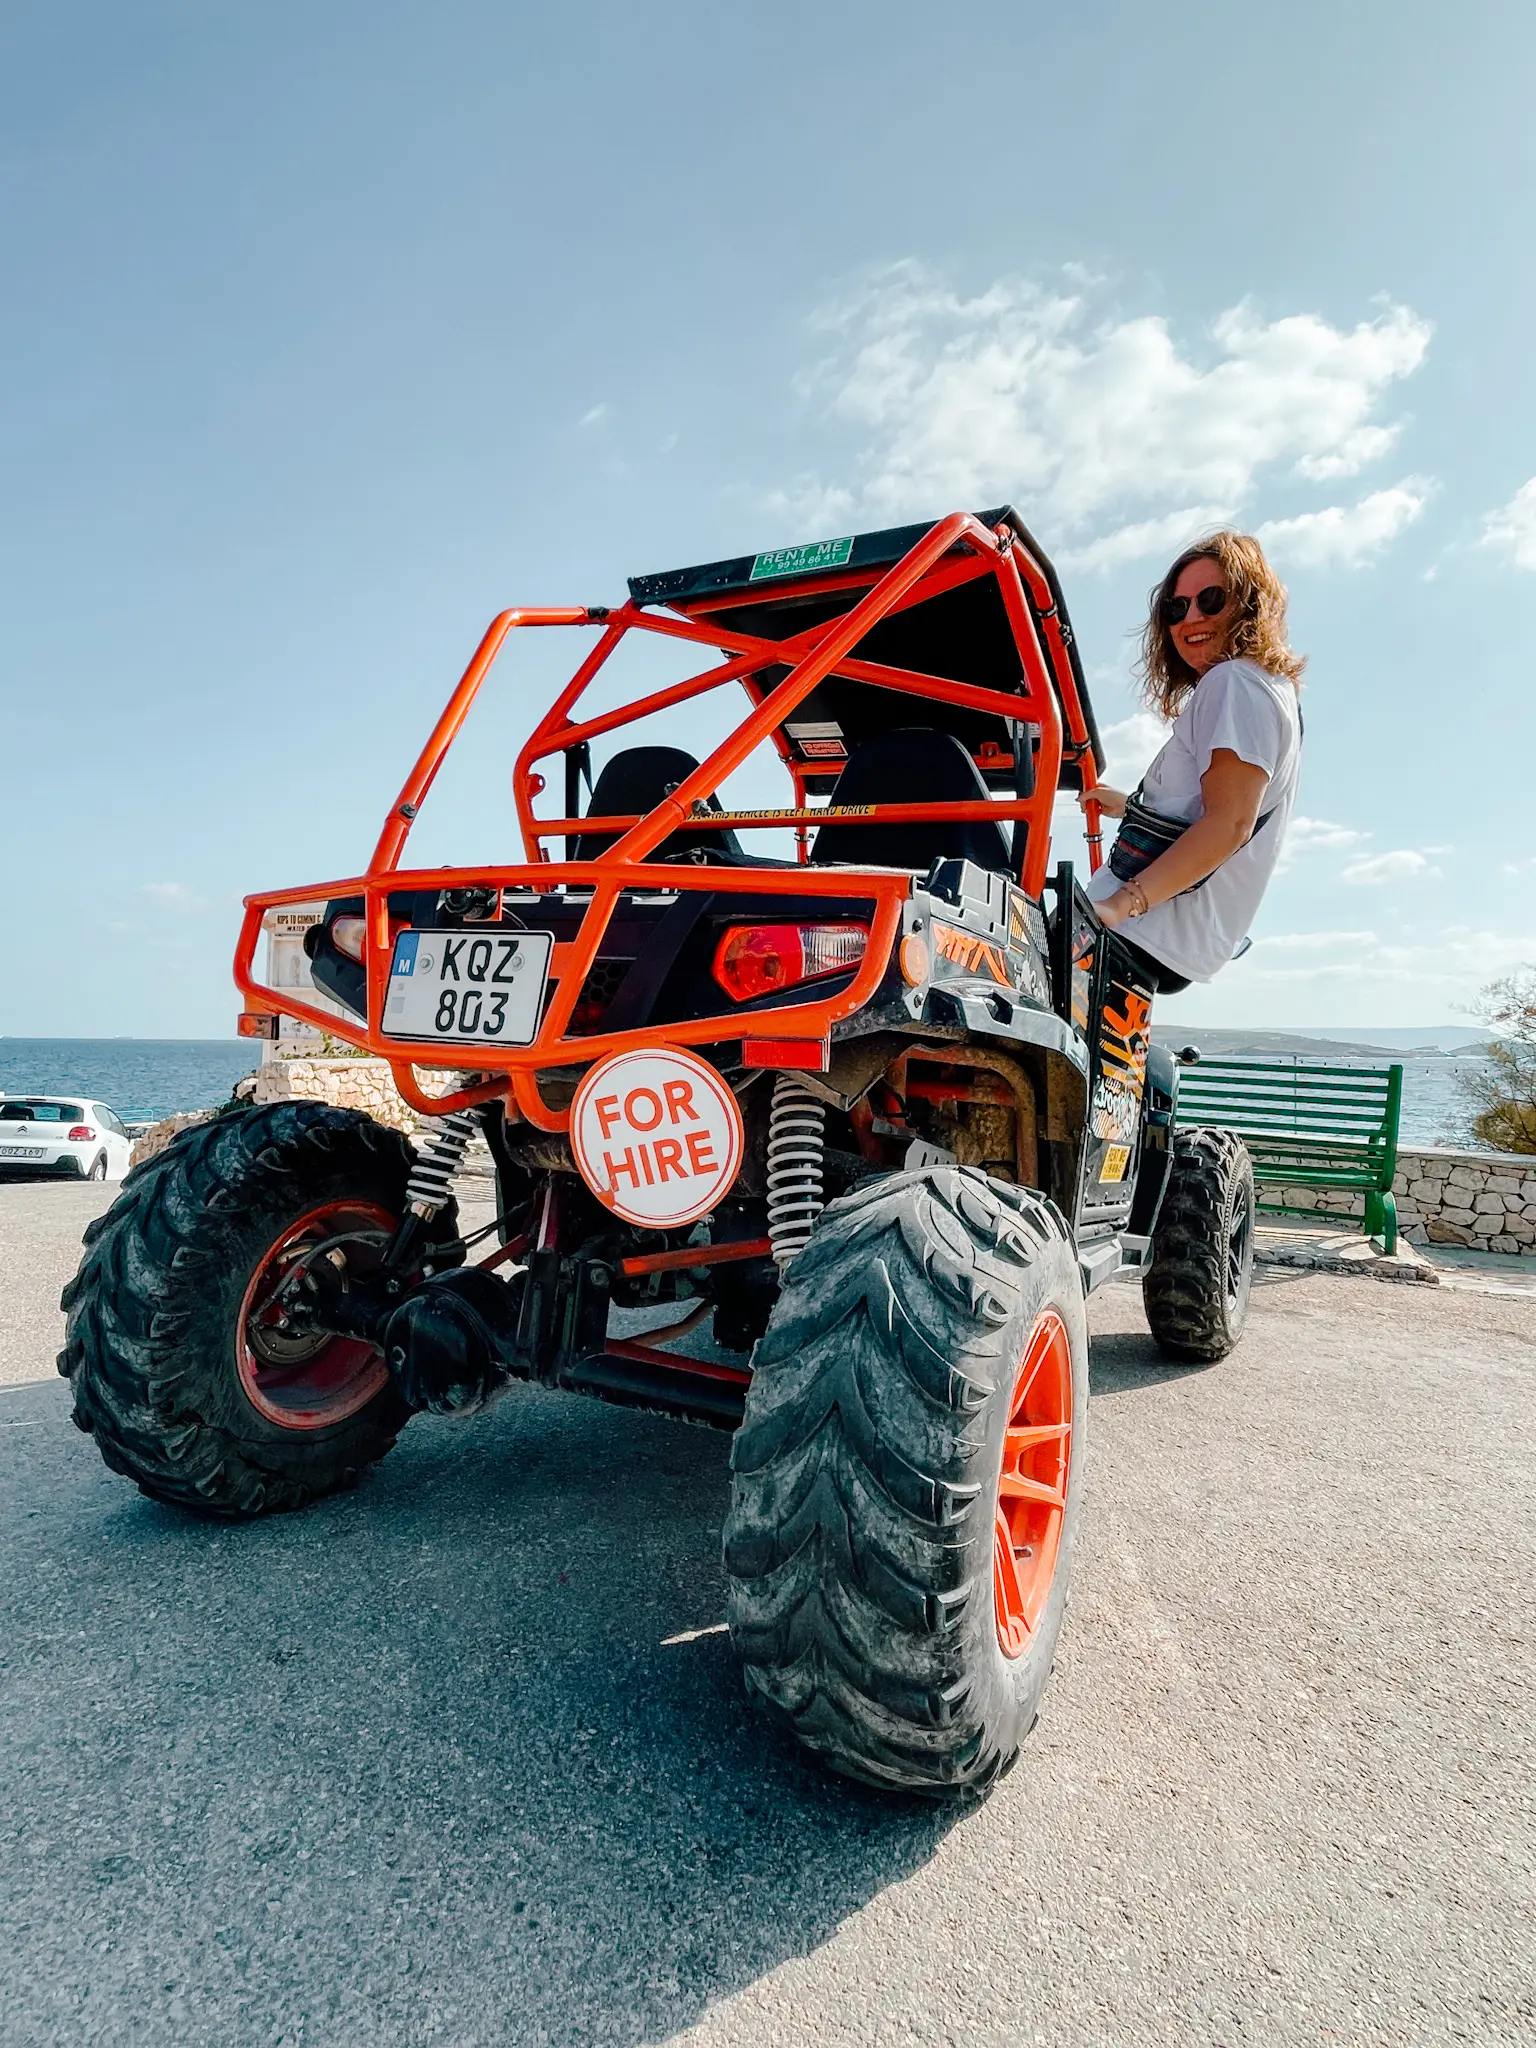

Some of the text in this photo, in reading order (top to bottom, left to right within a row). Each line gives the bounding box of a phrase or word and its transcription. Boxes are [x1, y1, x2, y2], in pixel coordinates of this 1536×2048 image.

[763, 540, 843, 565] RENT ME
[777, 560, 790, 570] 99
[793, 557, 806, 566] 49
[808, 554, 821, 564] 86
[824, 552, 836, 561] 41
[734, 809, 770, 819] VEHICLE
[772, 809, 780, 818] IS
[785, 808, 804, 817] LEFT
[809, 807, 836, 816] HAND
[841, 804, 870, 815] DRIVE
[398, 959, 410, 973] M
[440, 938, 520, 983] KQZ
[434, 989, 509, 1035] 803
[595, 1080, 701, 1140] FOR
[603, 1129, 719, 1193] HIRE
